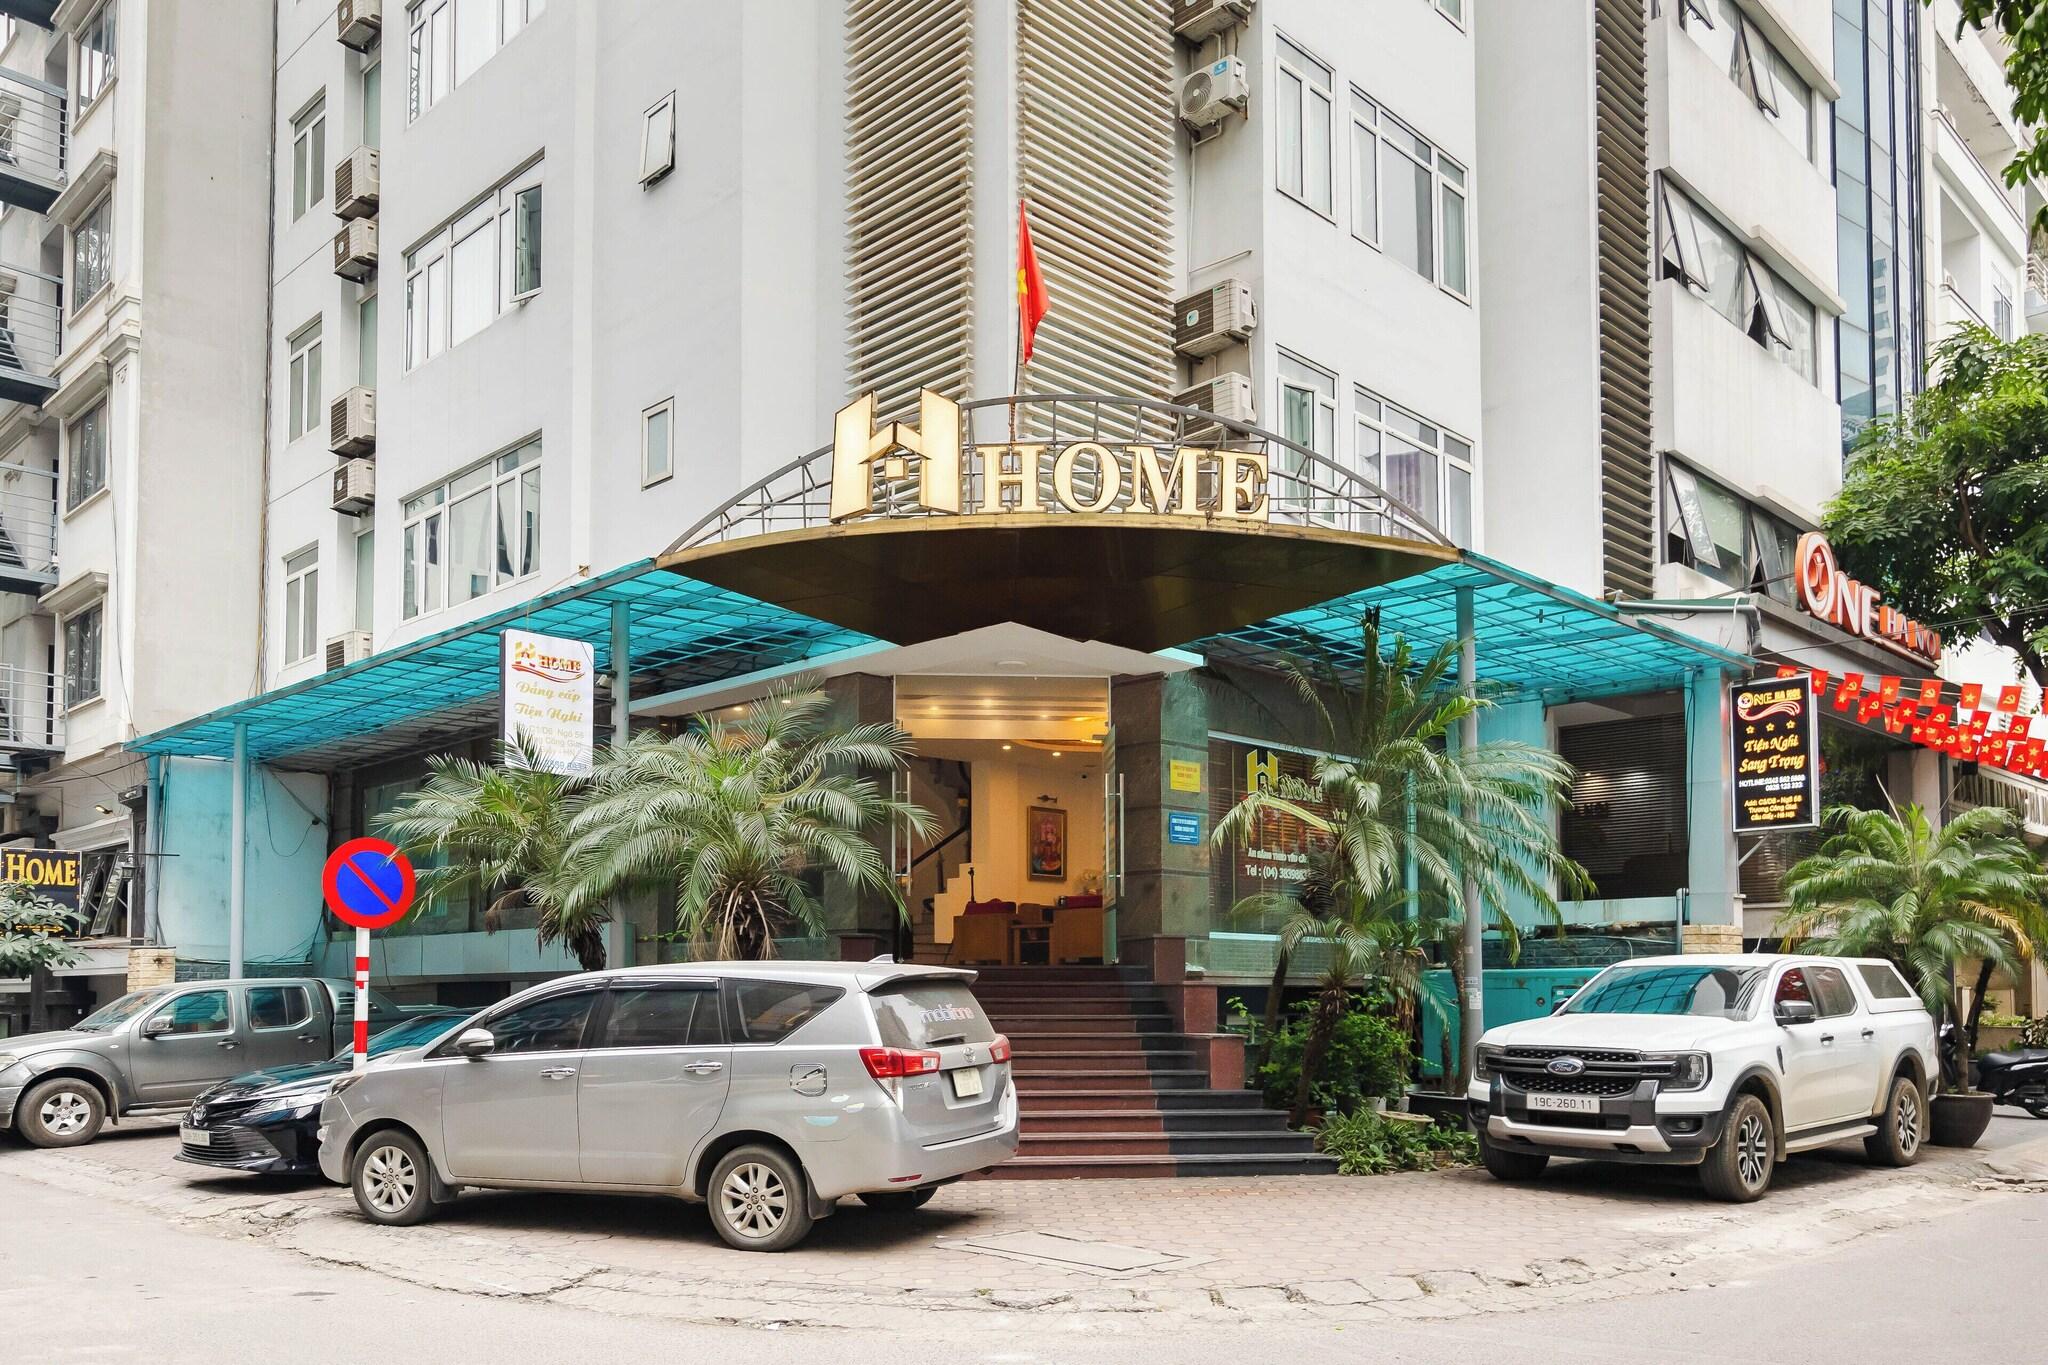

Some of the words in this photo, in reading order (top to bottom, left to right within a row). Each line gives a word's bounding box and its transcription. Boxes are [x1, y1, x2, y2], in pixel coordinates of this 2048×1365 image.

[974, 442, 1270, 522] HOME
[1795, 531, 1881, 638] ONE
[538, 655, 582, 672] HOME
[1738, 692, 1773, 709] ONE
[1739, 758, 1768, 774] Sang
[1768, 754, 1805, 770] Trọng
[6, 854, 76, 886] HOME
[1263, 865, 1278, 880] (04)
[1554, 1061, 1574, 1072] Ford
[1534, 1096, 1592, 1110] 19C-260.11
